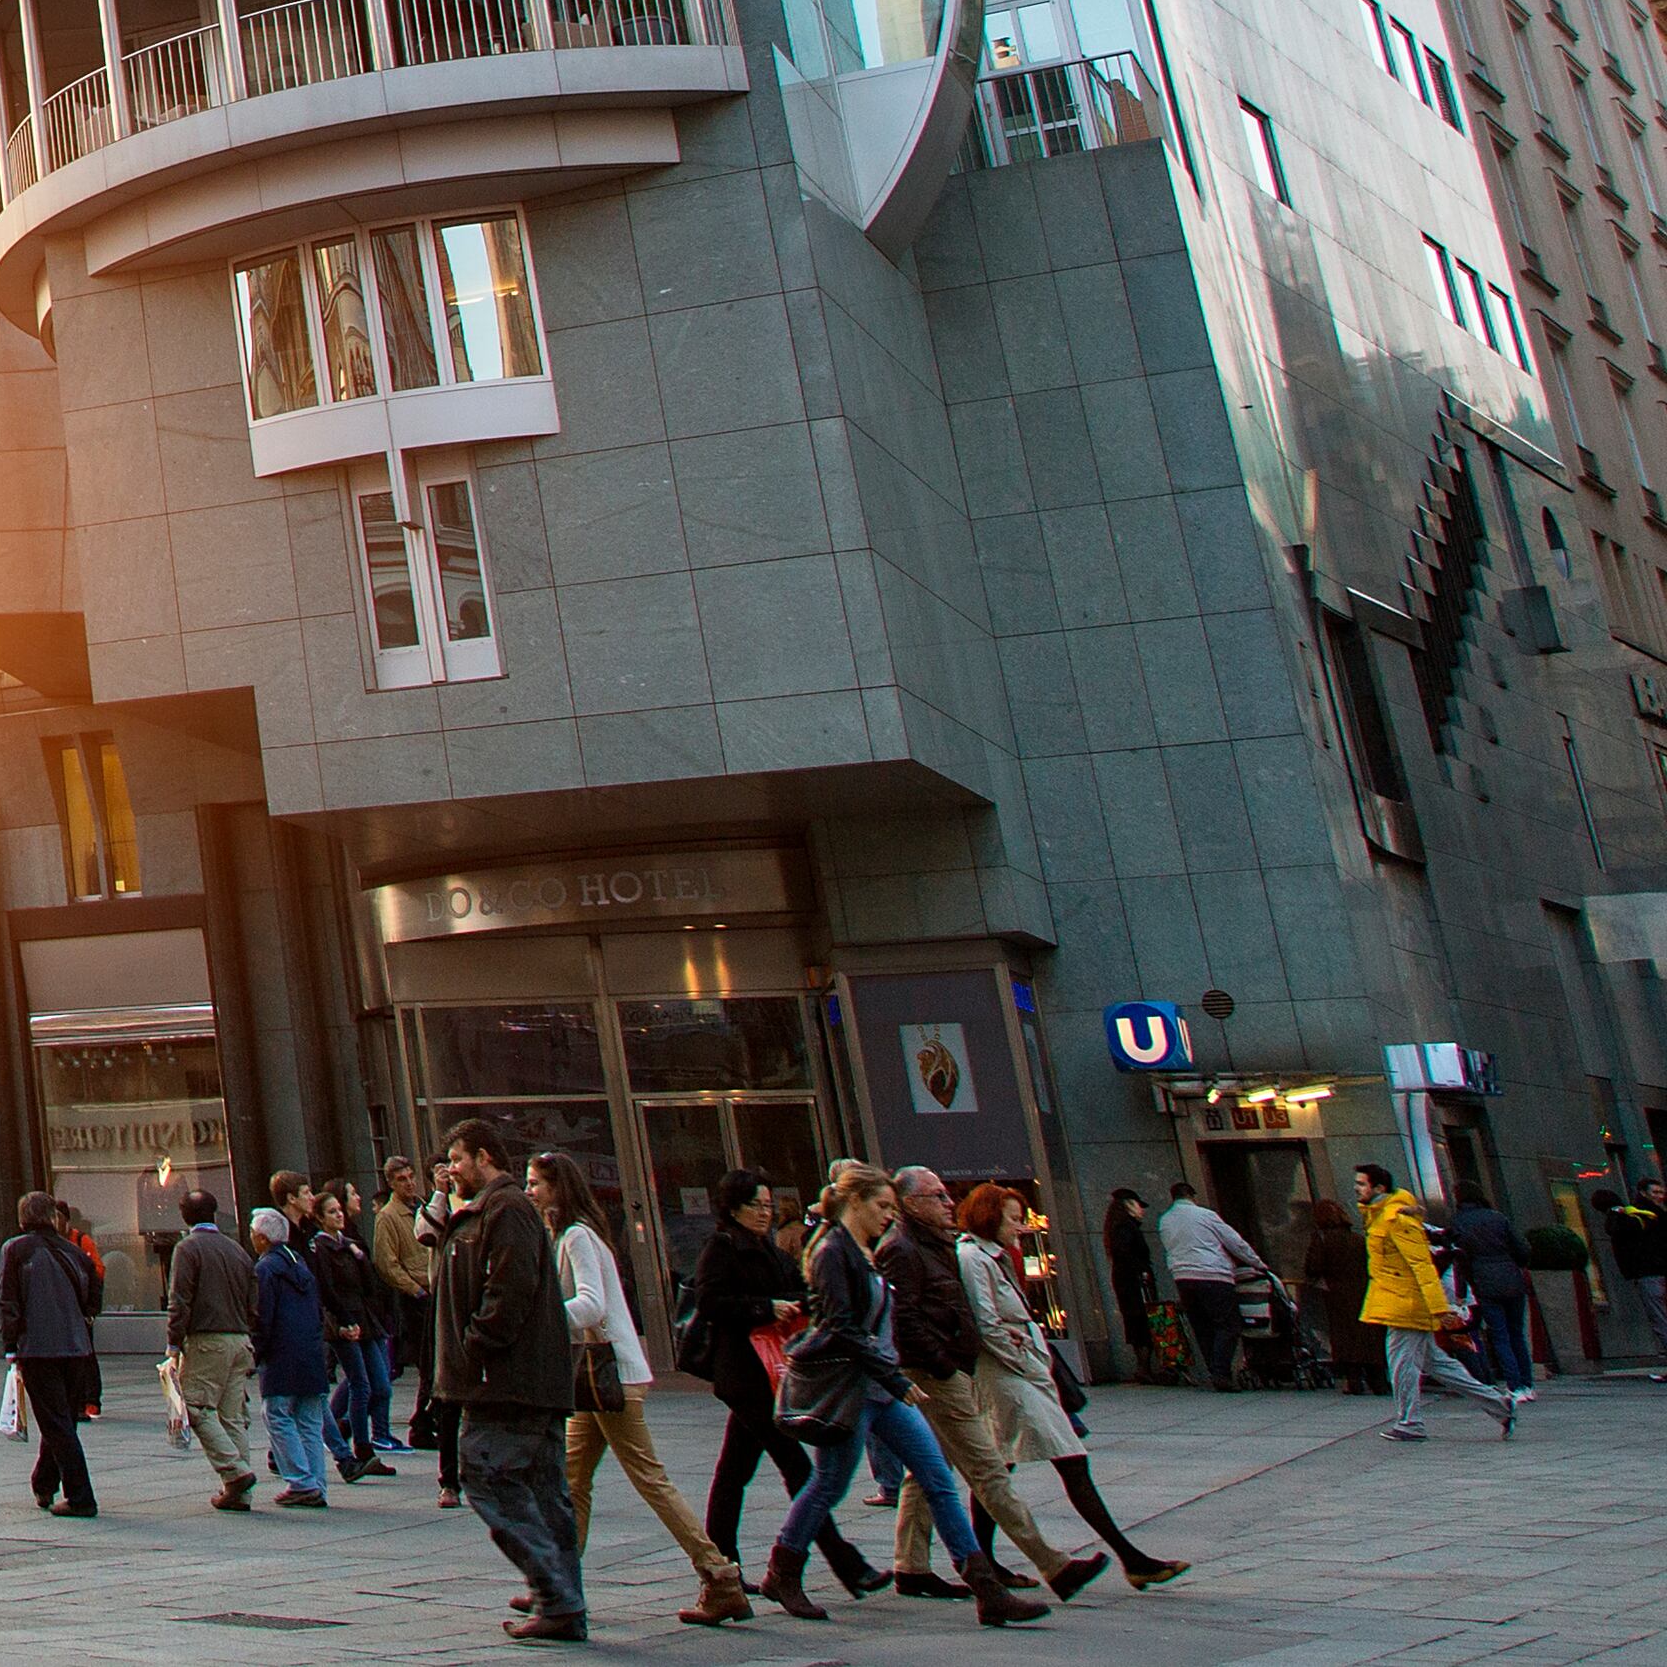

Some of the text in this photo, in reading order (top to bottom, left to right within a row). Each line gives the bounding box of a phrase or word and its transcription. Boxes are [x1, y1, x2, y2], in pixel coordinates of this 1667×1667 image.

[576, 867, 724, 907] HOTEL
[1115, 1016, 1169, 1064] U
[1235, 1109, 1286, 1126] U1 U3
